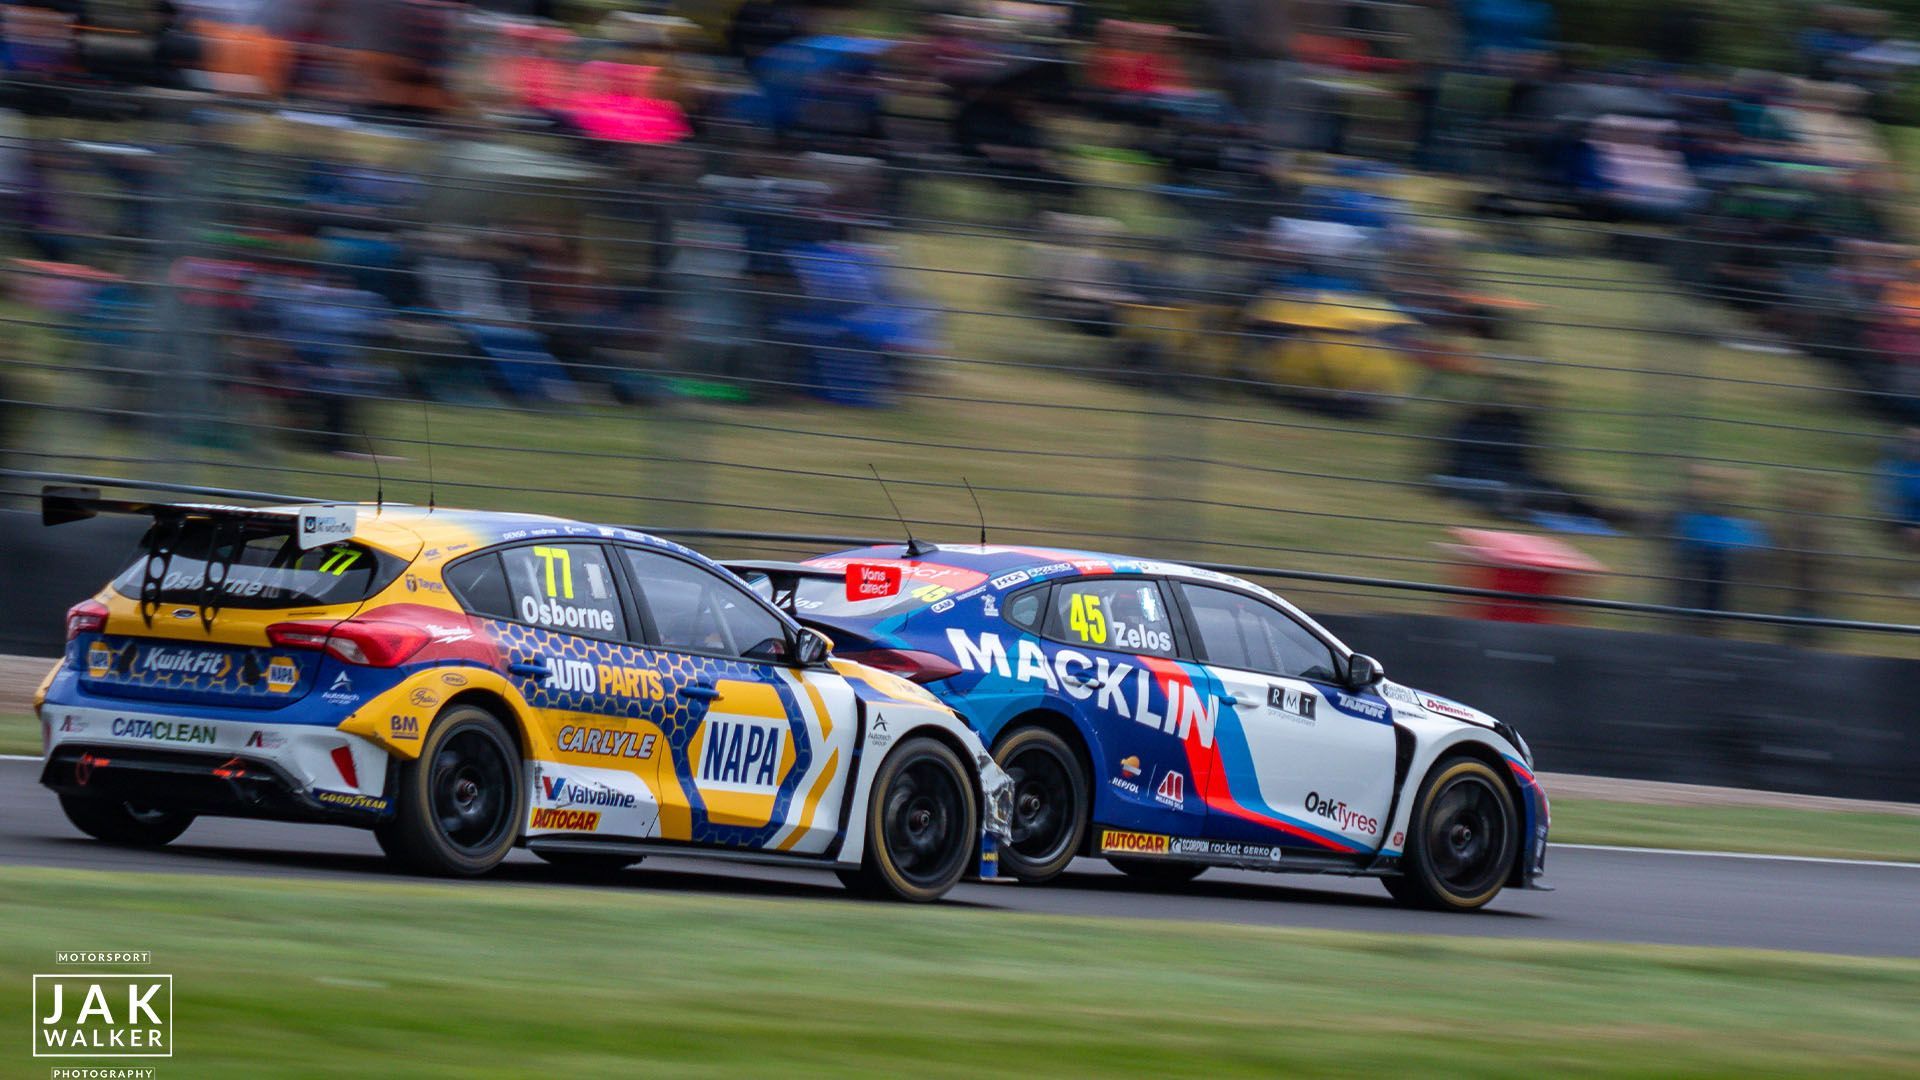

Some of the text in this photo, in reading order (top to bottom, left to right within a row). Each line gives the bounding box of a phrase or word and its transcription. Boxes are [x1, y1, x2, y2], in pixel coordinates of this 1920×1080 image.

[319, 547, 362, 577] 77
[533, 547, 574, 599] 77
[861, 567, 887, 581] Vans
[161, 570, 264, 597] Osbrne
[859, 582, 891, 596] direct
[522, 595, 615, 631] Osborne
[933, 600, 952, 612] CAM
[1069, 592, 1107, 645] 45
[1112, 621, 1172, 652] Zelos
[545, 656, 665, 702] AUTO PARTS
[945, 627, 1220, 750] MACKLIN
[1426, 698, 1477, 719] Dynamics
[111, 716, 218, 745] CATACLEAN
[391, 715, 419, 732] BM
[557, 725, 656, 760] CARLYLE
[703, 720, 780, 786] NAPA
[566, 782, 638, 809] Valvoline
[1112, 776, 1139, 794] REPSOL
[319, 792, 388, 810] GOODYEAR
[1304, 791, 1378, 835] OakTyres
[531, 807, 598, 831] AUTOCAR
[1104, 832, 1166, 853] AUTOCAR
[1181, 838, 1210, 852] SCORPION
[1210, 843, 1241, 855] rocket
